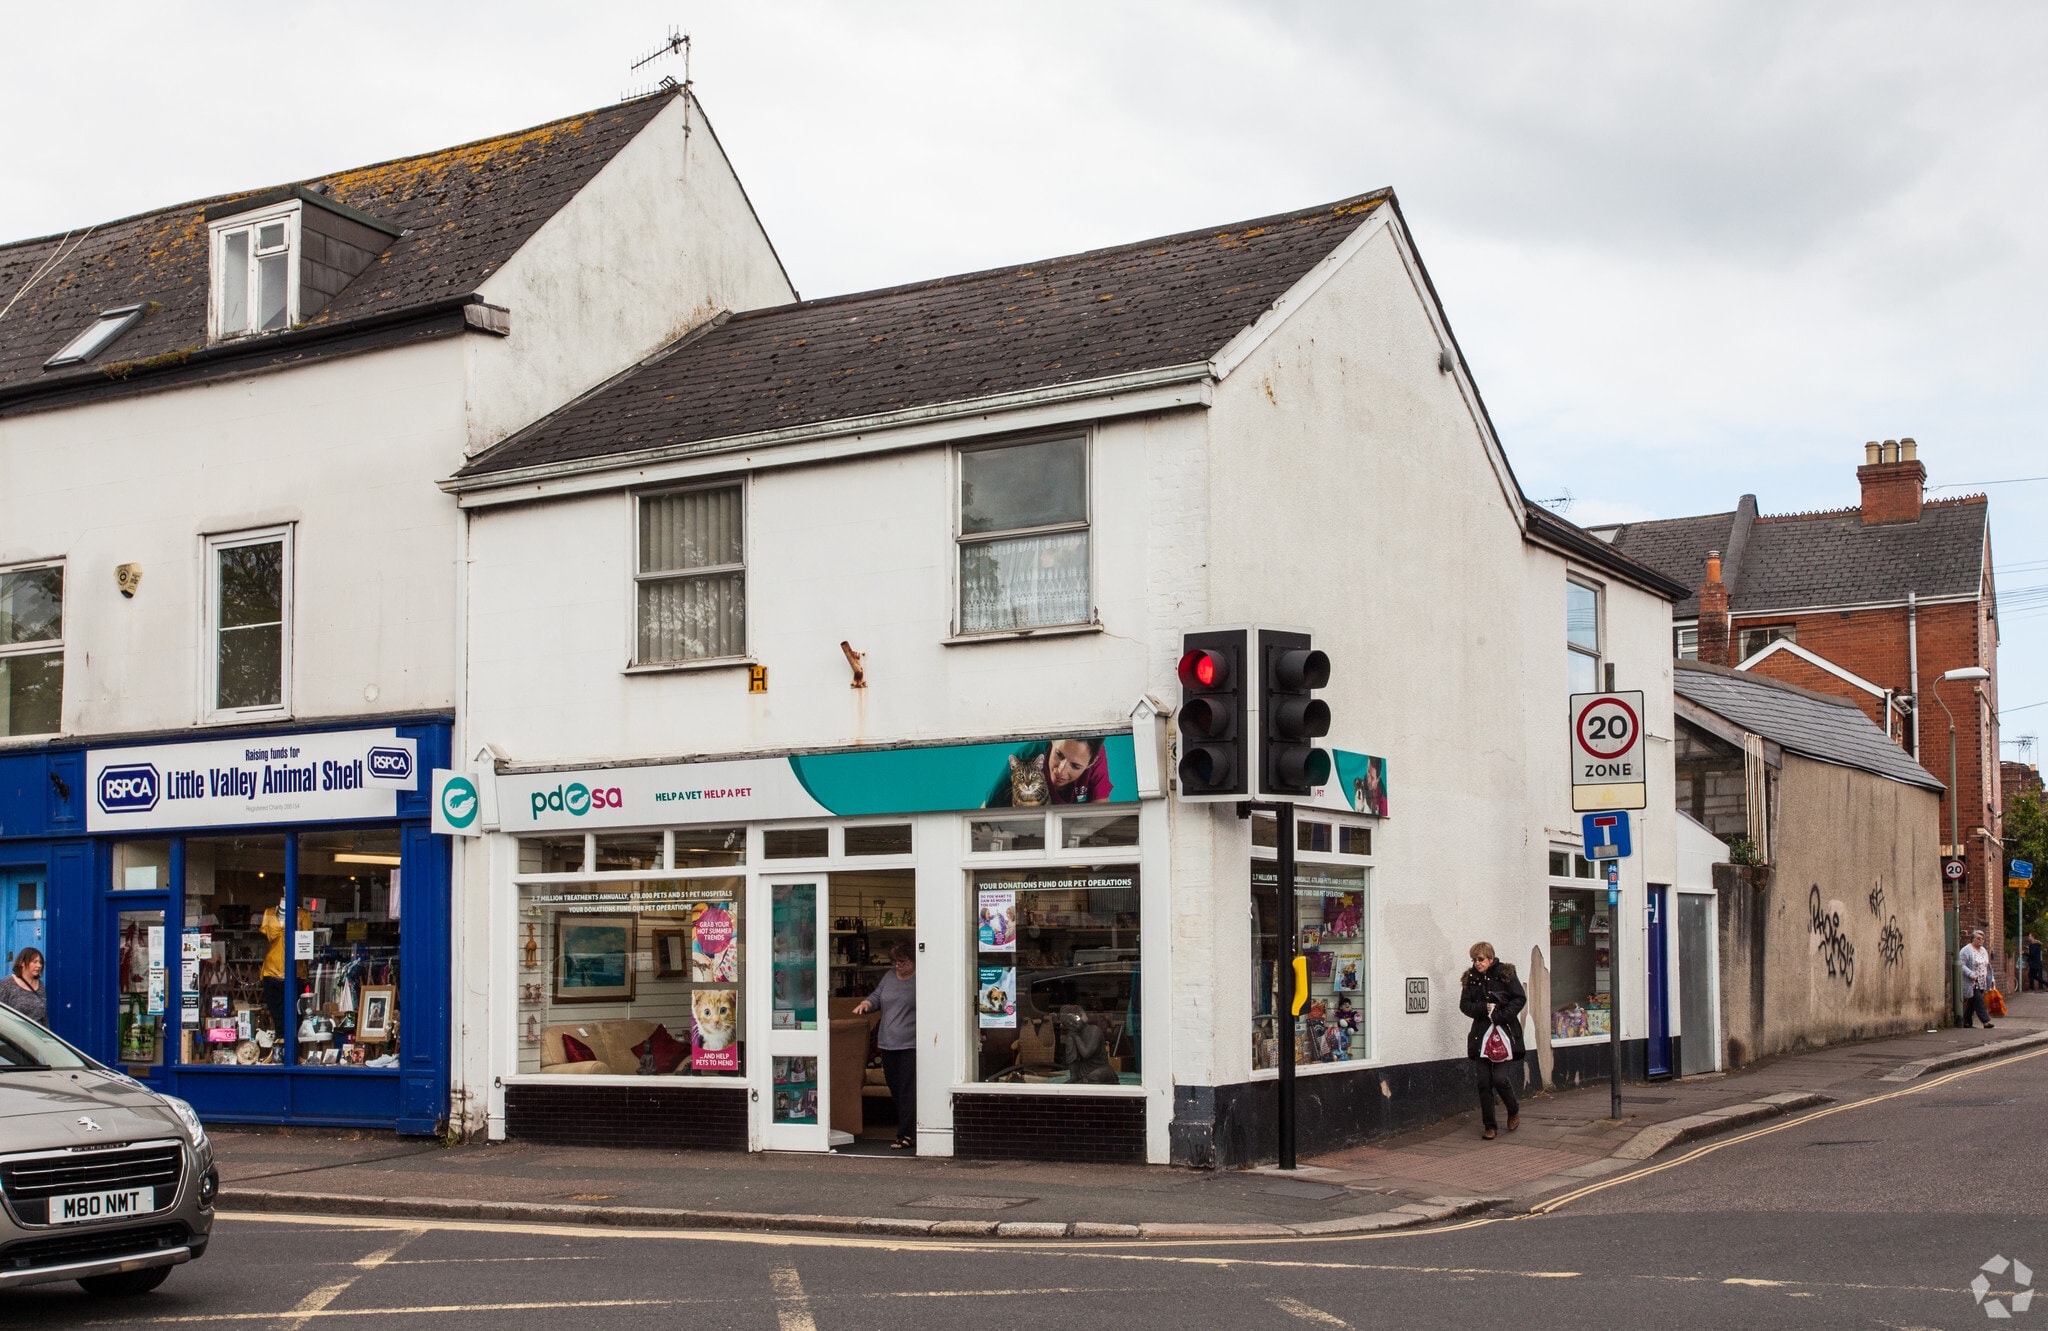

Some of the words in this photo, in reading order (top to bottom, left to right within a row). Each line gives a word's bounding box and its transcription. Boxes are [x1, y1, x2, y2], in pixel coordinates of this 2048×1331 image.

[751, 668, 765, 690] H
[1588, 715, 1628, 740] 20
[245, 749, 269, 762] Raising
[270, 747, 288, 760] funds
[289, 746, 300, 758] for
[373, 755, 407, 770] RSPCA
[1585, 763, 1632, 777] ZONE
[106, 777, 152, 799] RSPCA
[167, 770, 205, 800] Little
[209, 767, 257, 800] Valley
[262, 761, 317, 794] Animal
[655, 791, 677, 802] HELP
[678, 791, 685, 801] A
[685, 790, 702, 800] VET
[704, 788, 726, 799] HELP
[727, 788, 734, 798] A
[735, 787, 752, 798] PET
[1947, 866, 1962, 874] 20
[979, 882, 997, 890] YOUR
[998, 881, 1037, 889] DONATIONS
[1058, 880, 1073, 888] OUR
[1088, 878, 1132, 887] OPERATIONS
[564, 893, 598, 901] TREATMENTS
[599, 893, 629, 901] ANNUALLY,
[1409, 981, 1426, 993] CECIL
[1409, 997, 1426, 1010] ROAD
[64, 1195, 100, 1218] M80
[106, 1191, 139, 1214] NMT
